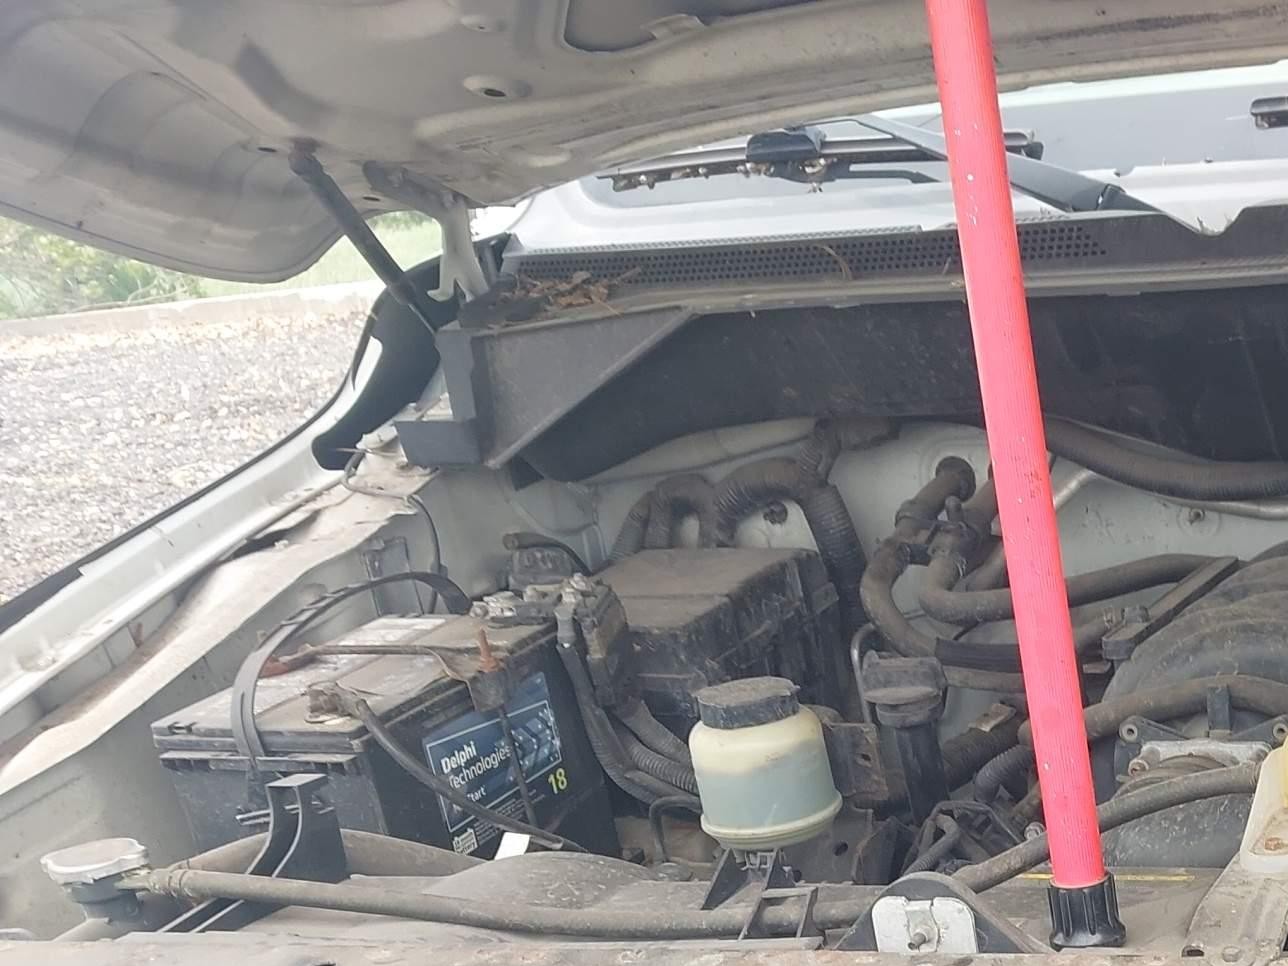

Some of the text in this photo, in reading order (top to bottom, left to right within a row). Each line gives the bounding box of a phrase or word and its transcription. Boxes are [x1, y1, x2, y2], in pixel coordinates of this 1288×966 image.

[440, 740, 477, 774] Delphi
[448, 744, 512, 789] Technologies
[466, 784, 487, 802] tart
[548, 767, 568, 794] 18
